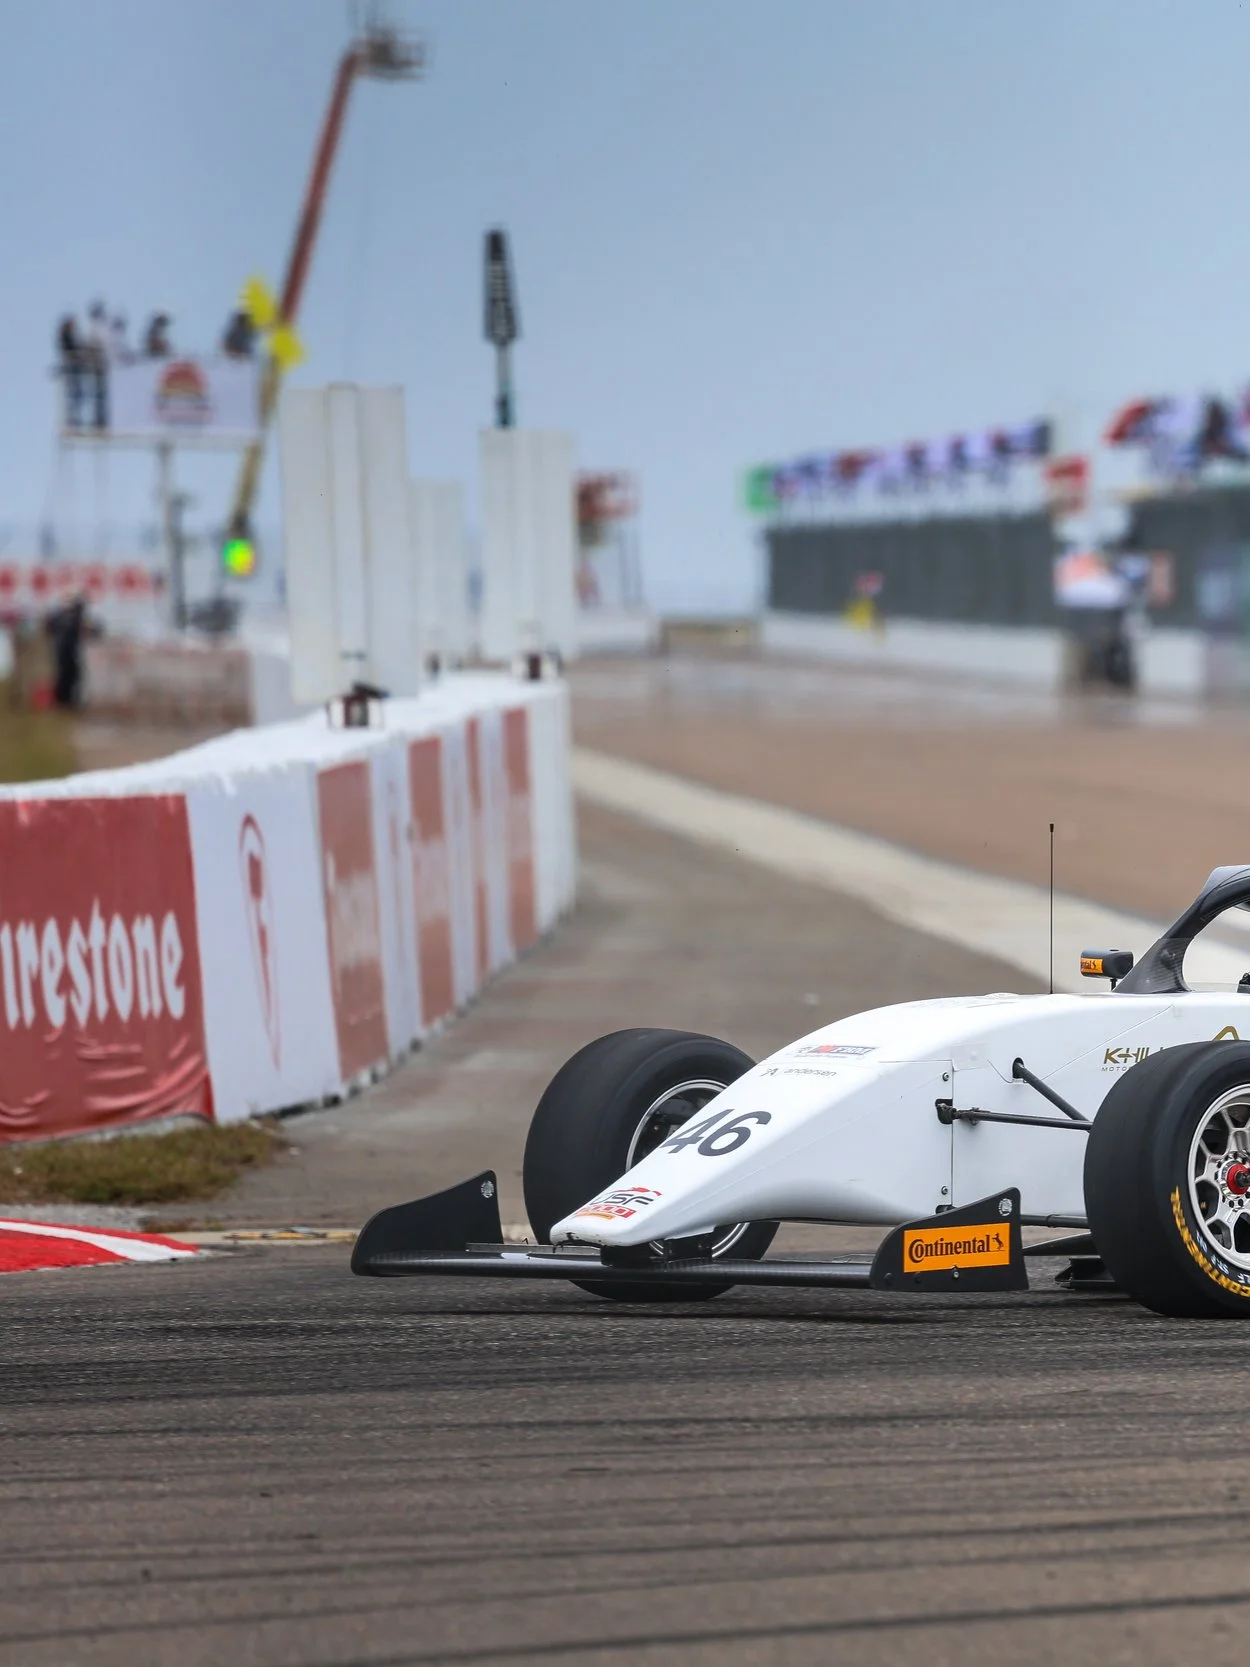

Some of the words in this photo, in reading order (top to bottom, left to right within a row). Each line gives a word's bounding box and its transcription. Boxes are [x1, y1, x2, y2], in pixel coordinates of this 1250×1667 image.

[783, 1067, 838, 1077] andersen
[660, 1108, 772, 1157] 46
[908, 1233, 991, 1264] Continental
